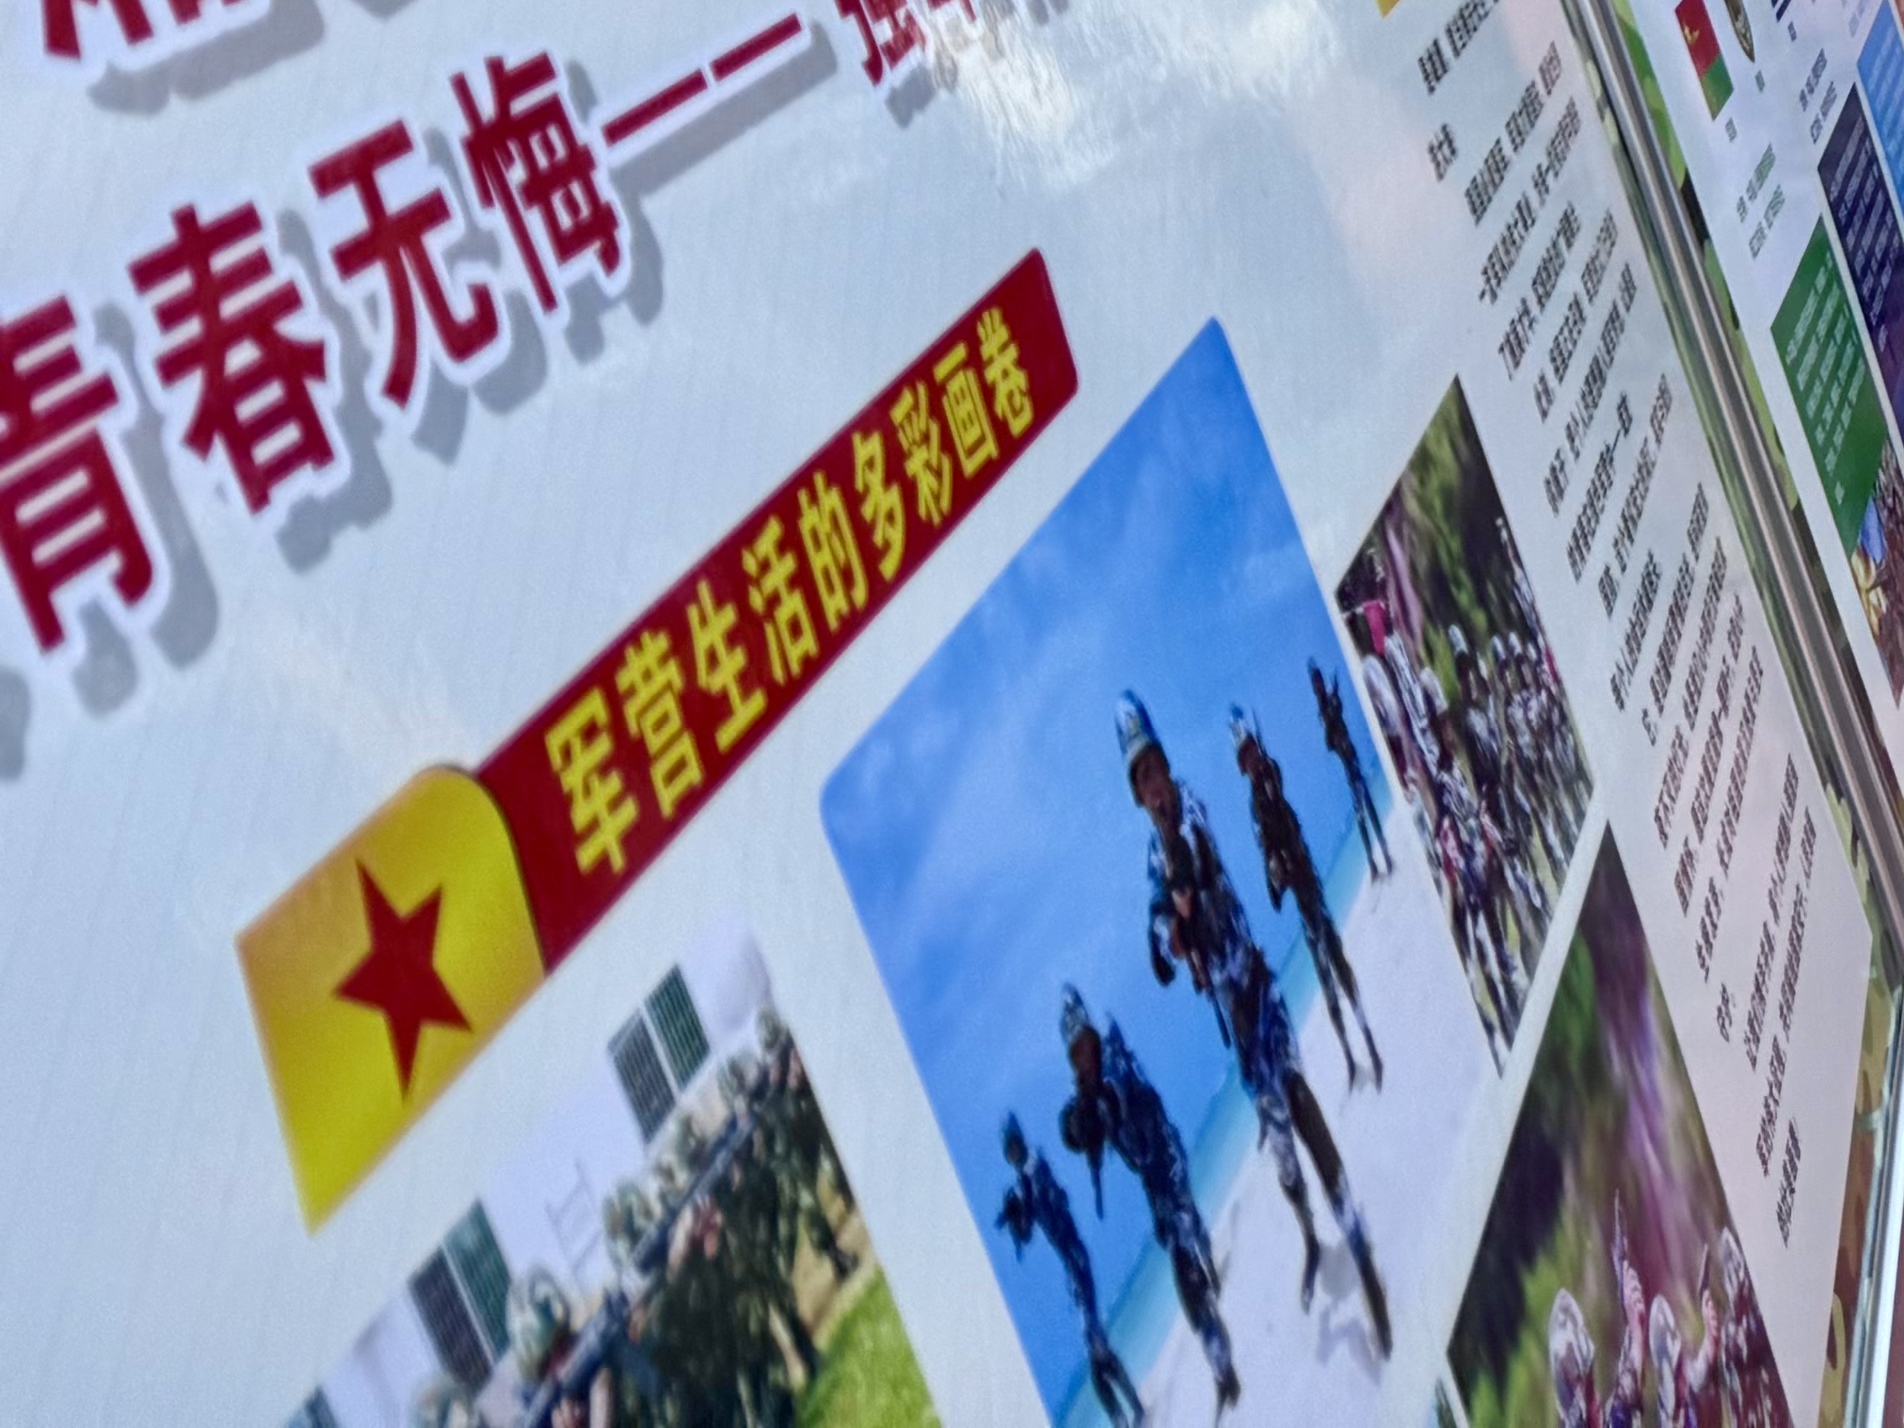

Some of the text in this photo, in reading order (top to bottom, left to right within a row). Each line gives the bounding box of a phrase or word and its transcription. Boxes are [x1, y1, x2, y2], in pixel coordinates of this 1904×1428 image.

[544, 305, 1037, 886] 军营生活的多彩画卷
